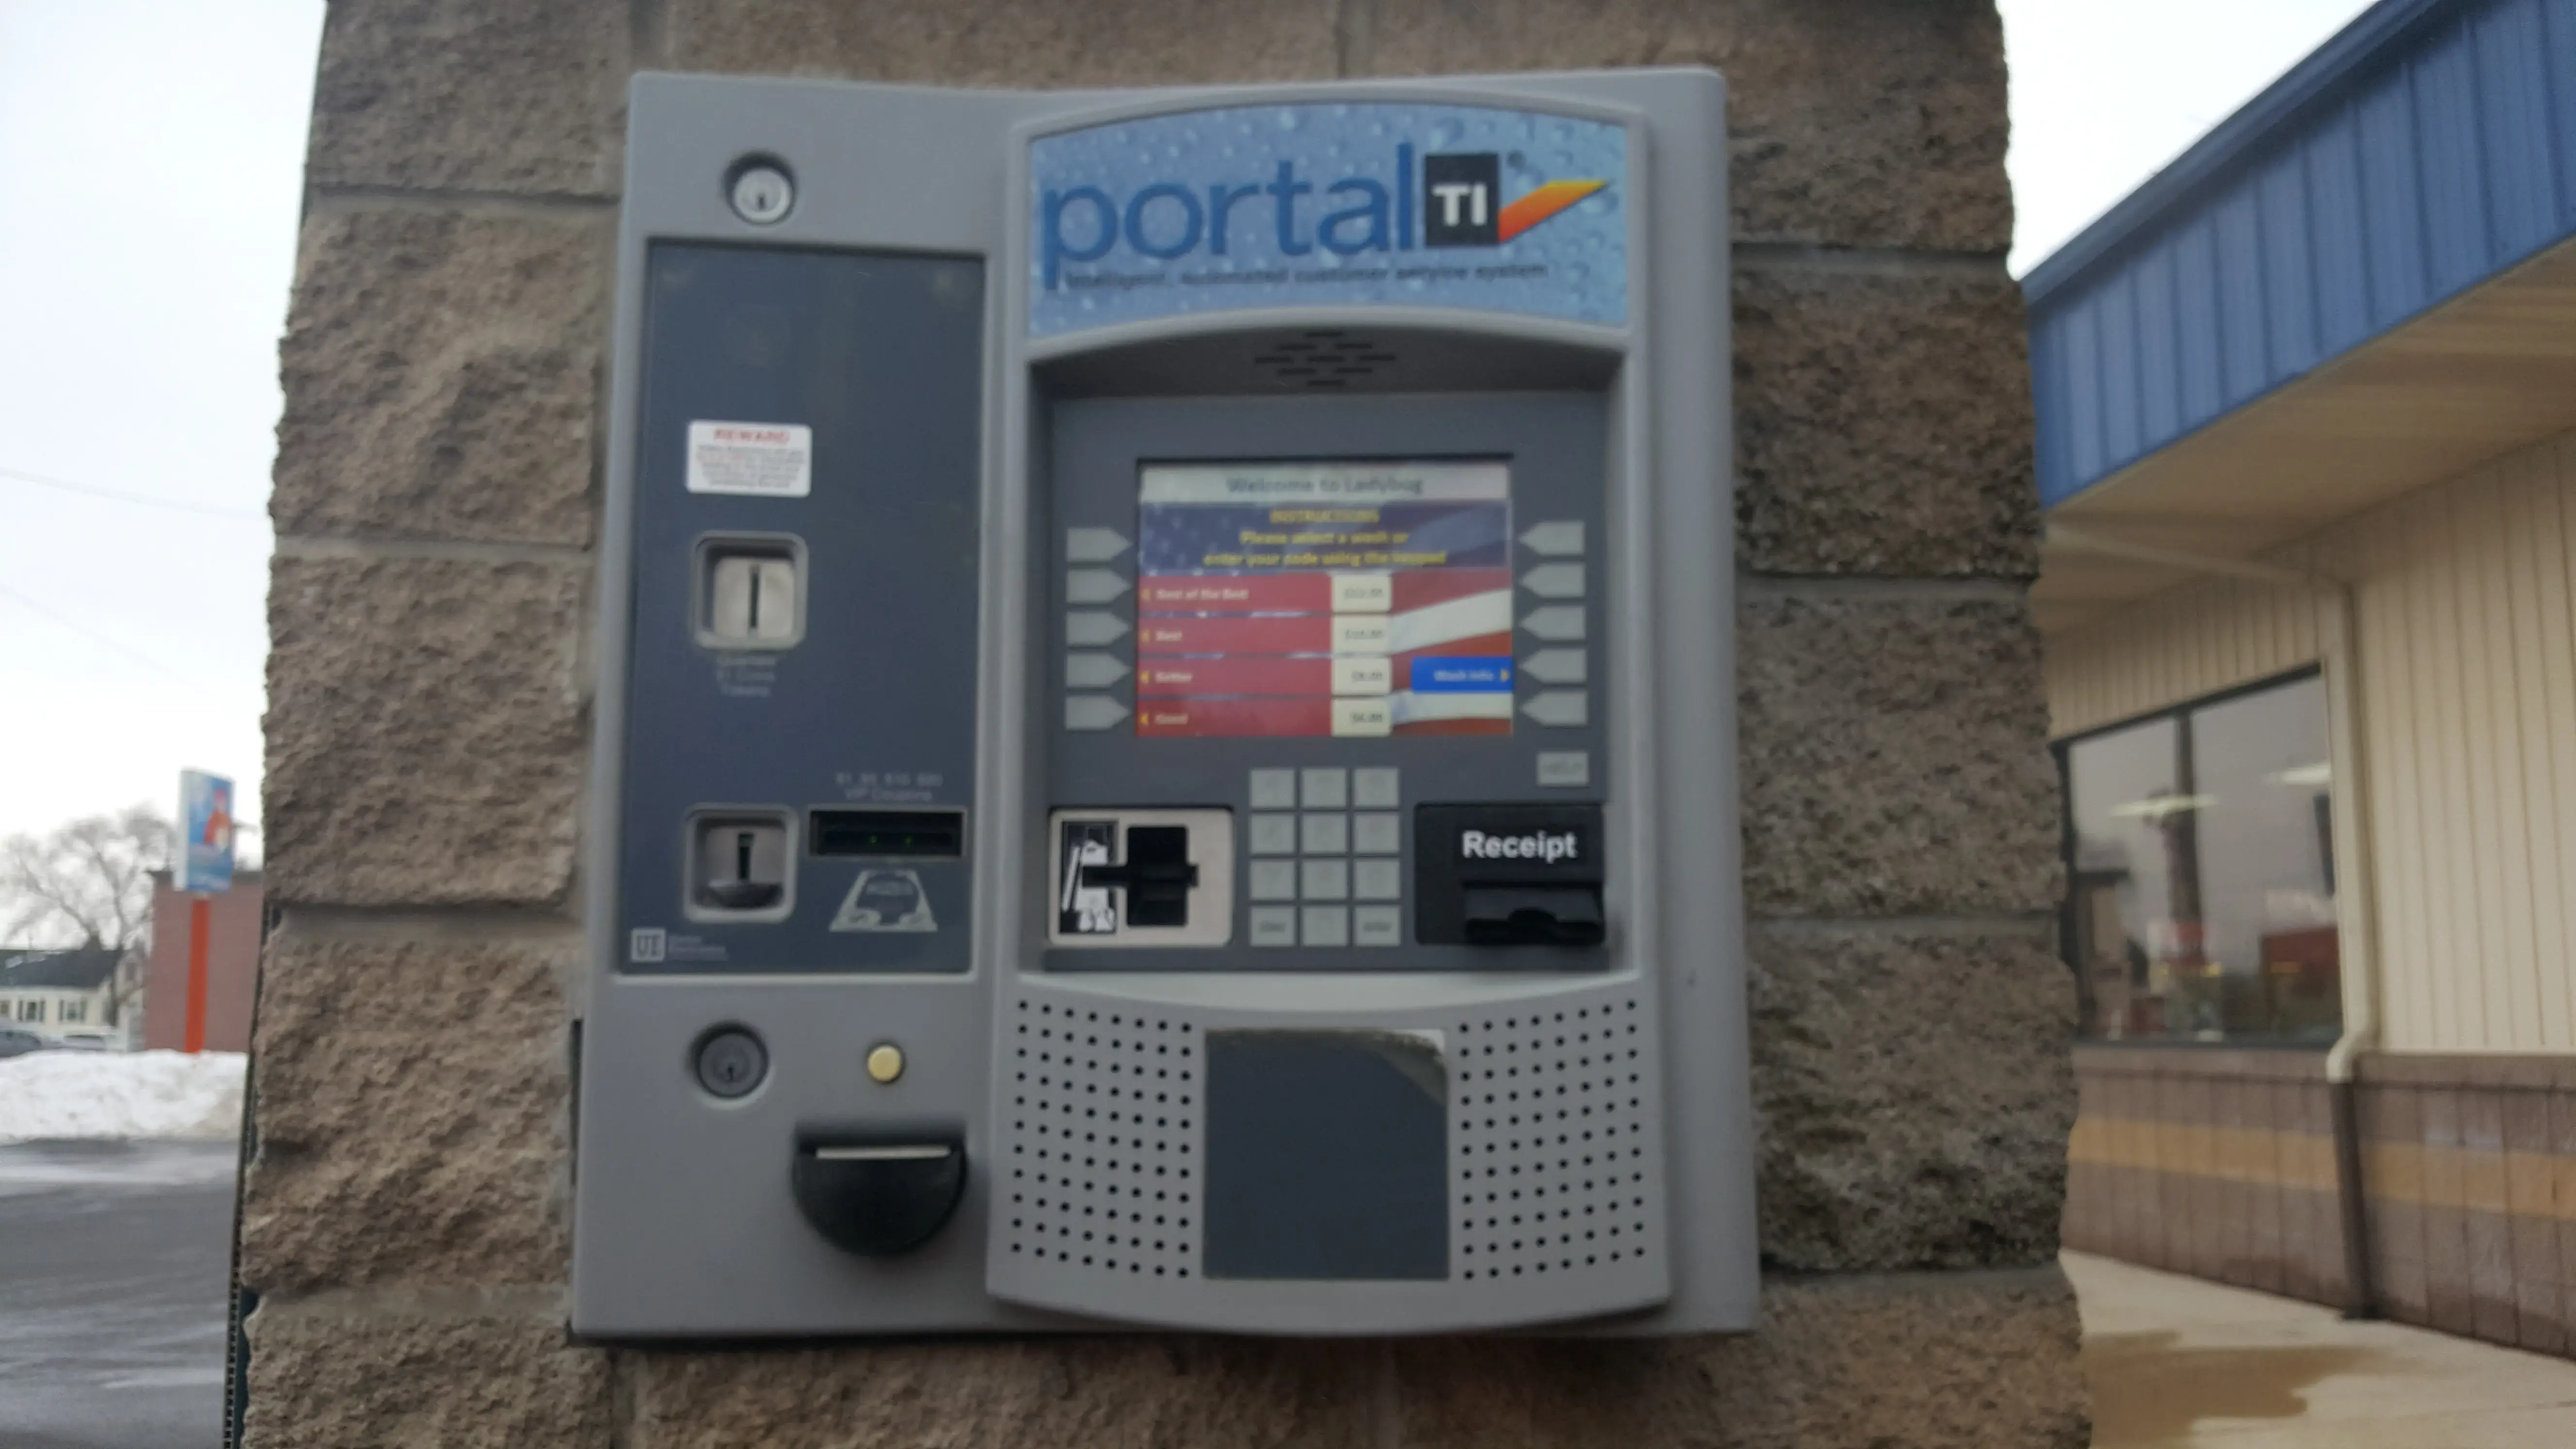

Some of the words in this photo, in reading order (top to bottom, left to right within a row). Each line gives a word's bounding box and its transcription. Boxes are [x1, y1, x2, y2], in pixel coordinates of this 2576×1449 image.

[1042, 143, 1413, 291] portal
[1432, 183, 1488, 226] TI
[1320, 478, 1340, 492] to
[1462, 829, 1578, 861] Receipt
